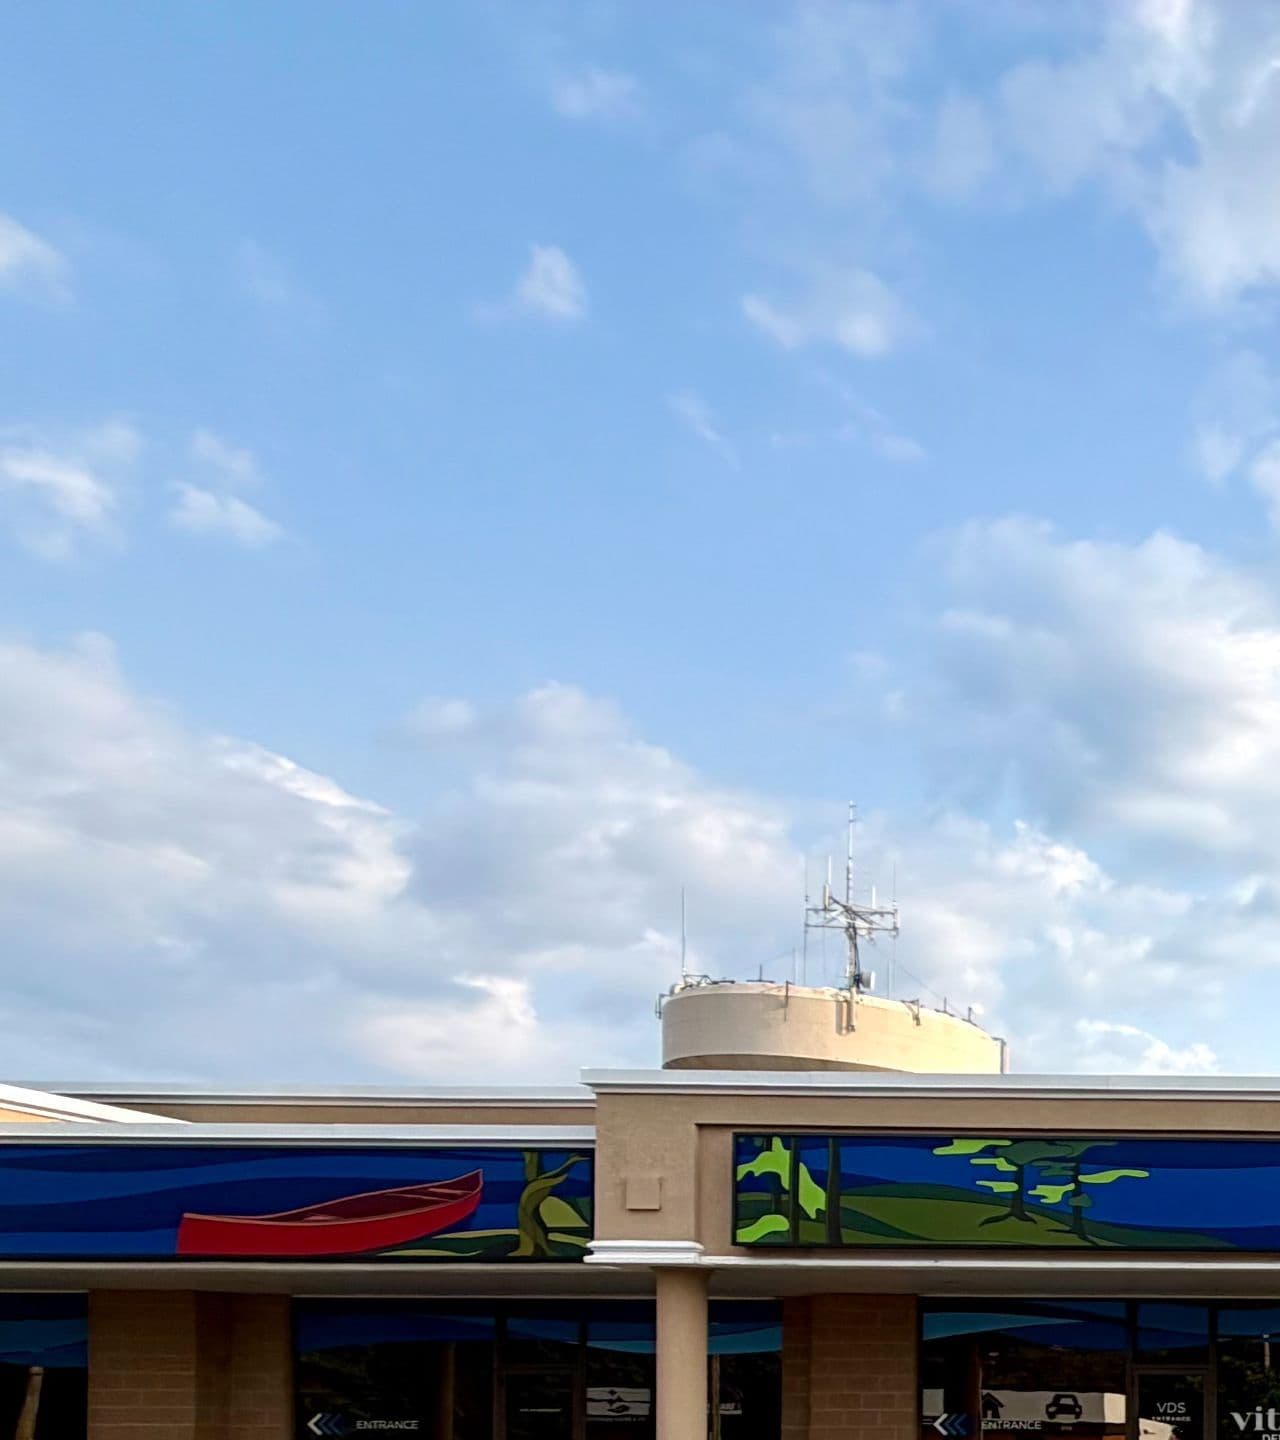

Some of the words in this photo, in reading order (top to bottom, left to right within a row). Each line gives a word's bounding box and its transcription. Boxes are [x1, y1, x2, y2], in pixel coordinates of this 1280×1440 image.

[1156, 1402, 1186, 1414] VDS
[355, 1420, 420, 1430] ENTRANCE
[981, 1420, 1042, 1431] ENTRANCE
